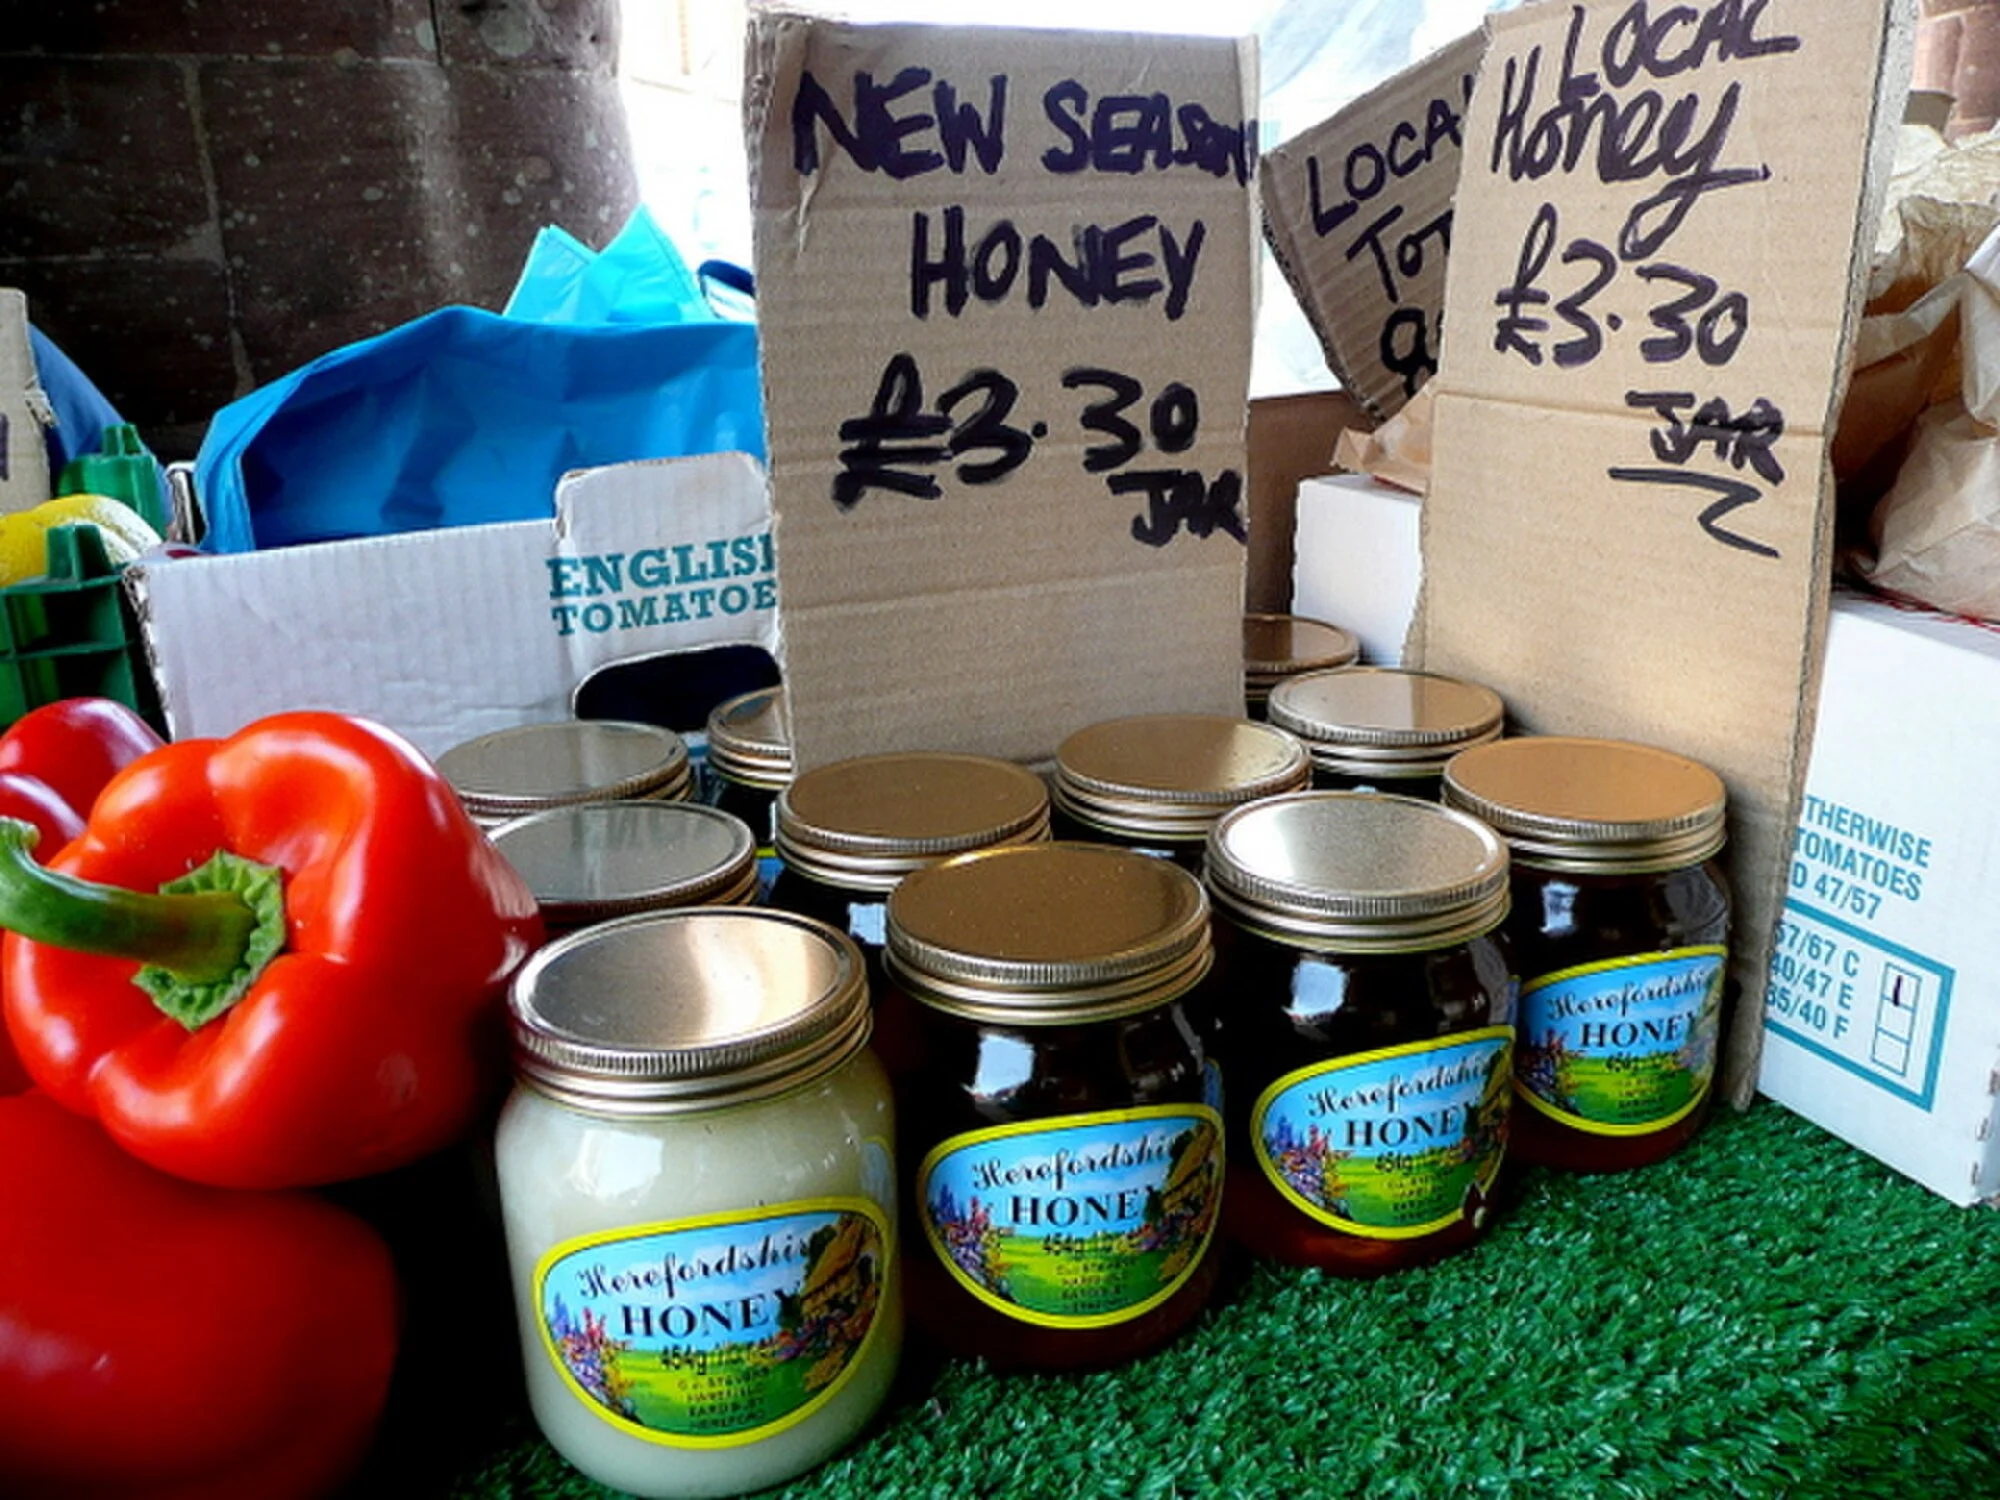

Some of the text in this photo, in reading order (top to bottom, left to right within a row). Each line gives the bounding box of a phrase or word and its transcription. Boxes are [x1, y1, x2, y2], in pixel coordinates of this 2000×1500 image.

[1558, 0, 1802, 103] LOCAL
[792, 67, 1258, 187] NEW SEASON
[908, 204, 1205, 320] HONEY
[1494, 203, 1748, 366] £3.30
[830, 352, 1198, 514] £3.30
[1625, 390, 1785, 486] JAR
[1106, 468, 1248, 546] JAR
[551, 579, 777, 636] TOMATOE
[1793, 825, 1922, 902] TOMATOES
[1806, 794, 1931, 868] THERWISE
[1814, 873, 1883, 920] 47/57
[1838, 982, 1854, 1011] E
[1843, 949, 1860, 978] C
[1833, 1015, 1849, 1039] F
